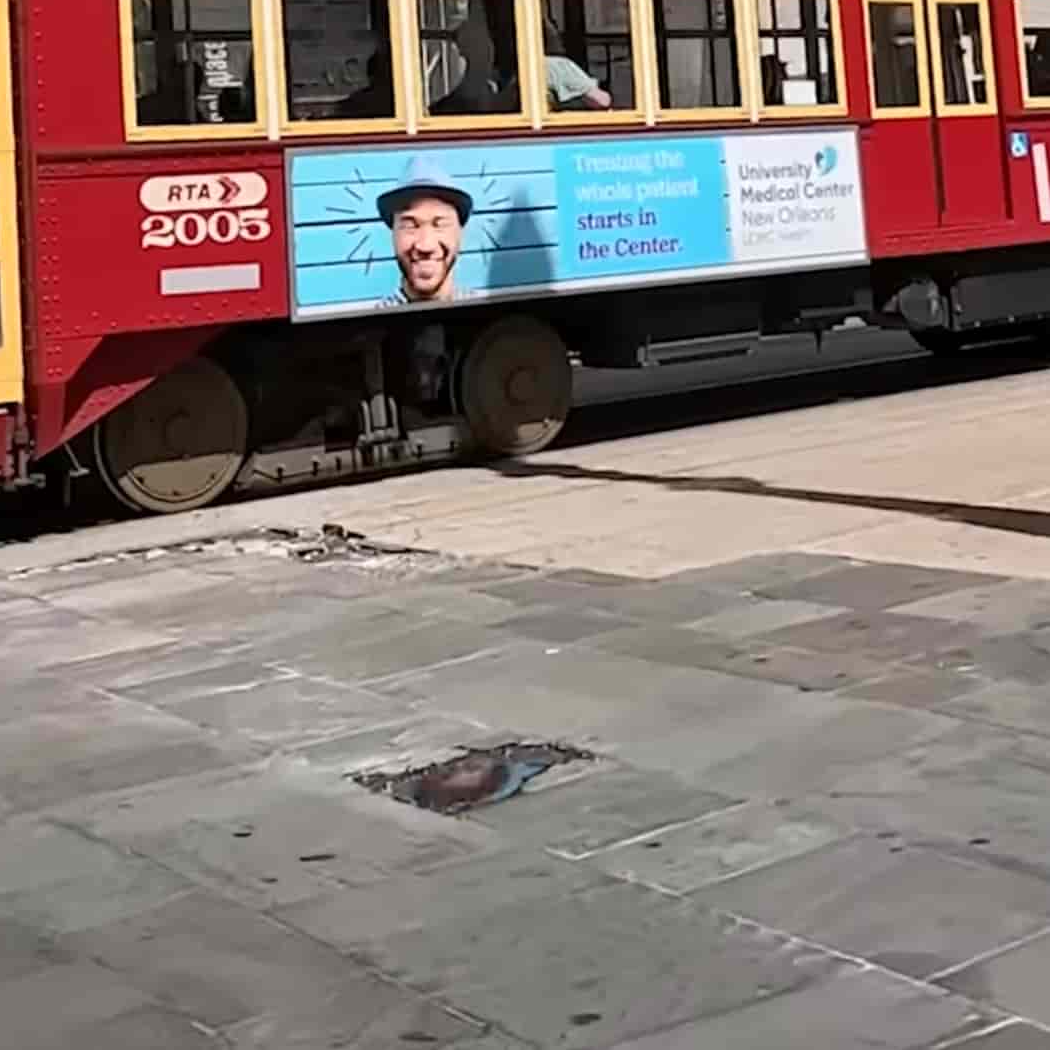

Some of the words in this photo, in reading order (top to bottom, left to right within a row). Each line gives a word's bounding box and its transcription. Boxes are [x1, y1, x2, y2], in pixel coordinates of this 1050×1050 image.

[739, 160, 812, 181] University
[167, 183, 211, 202] RTA
[741, 184, 799, 204] Medical
[804, 181, 854, 199] Center
[577, 210, 633, 230] starts
[639, 207, 657, 226] in
[742, 209, 775, 227] New
[778, 206, 836, 224] Orleans
[140, 208, 271, 249] 2005
[579, 241, 609, 260] the
[615, 237, 684, 257] Center.
